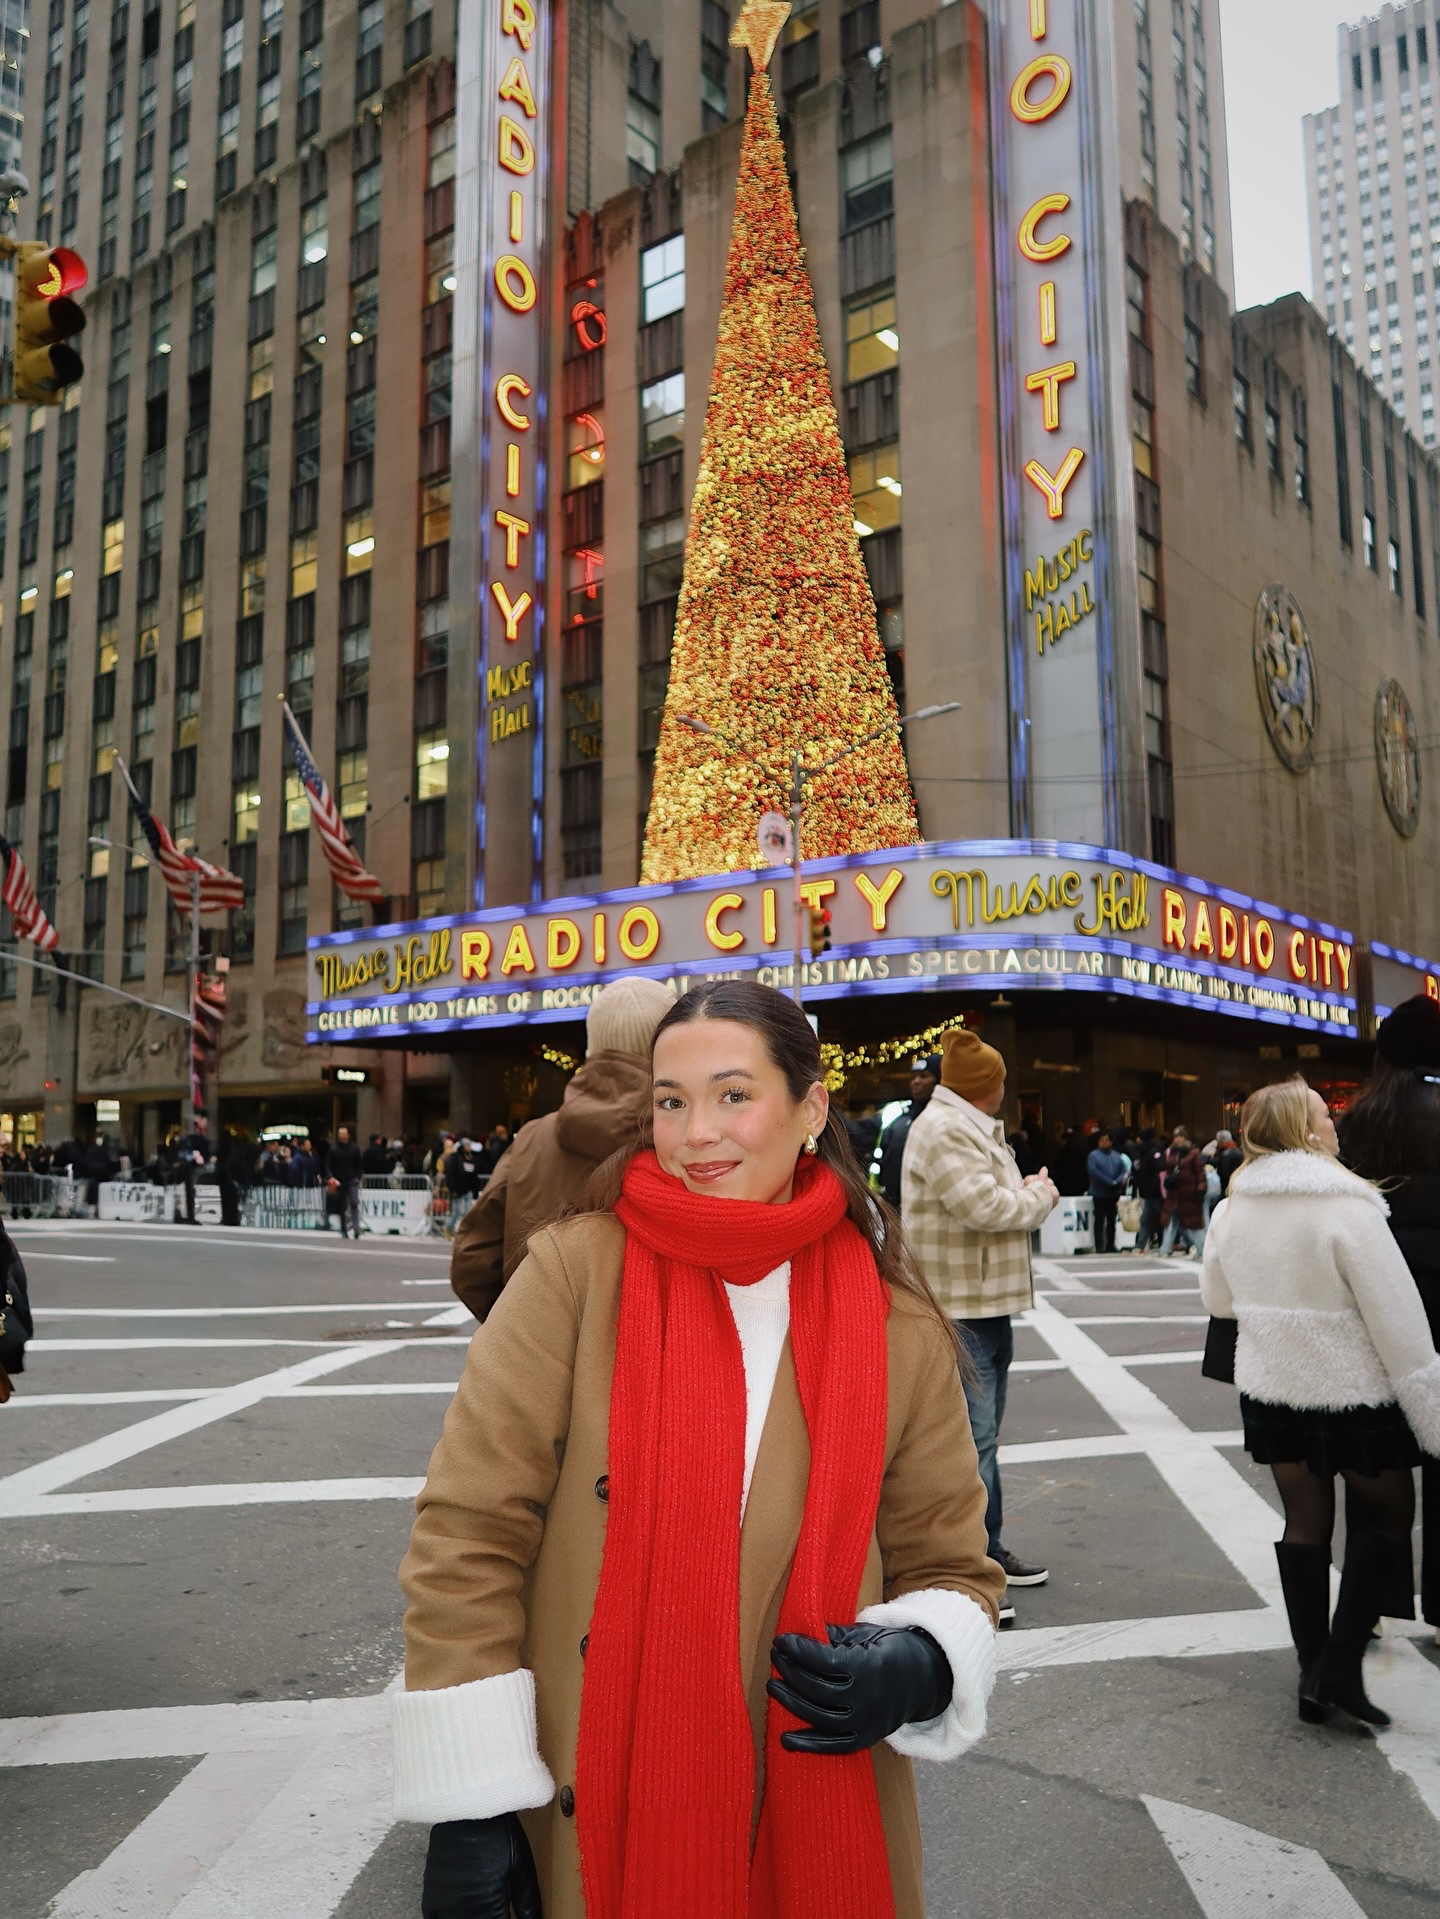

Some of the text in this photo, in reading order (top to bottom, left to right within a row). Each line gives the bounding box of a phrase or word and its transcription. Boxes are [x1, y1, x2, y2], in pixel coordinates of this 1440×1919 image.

[491, 0, 537, 641] RADIO CITY
[1018, 193, 1085, 520] CITY
[1036, 583, 1095, 655] HALL
[461, 868, 904, 980] RADIO CITY
[930, 869, 1150, 936] Music Hall
[1162, 887, 1351, 991] RADIO CITY
[316, 928, 453, 998] Music Hall
[318, 1005, 399, 1031] CELEBRATE
[408, 1001, 438, 1022] 100
[447, 996, 498, 1018] YEARS
[507, 991, 532, 1013] OF
[757, 955, 890, 988] CHISTMAS
[1121, 956, 1150, 984] NOW
[1154, 963, 1203, 995] PLAYING
